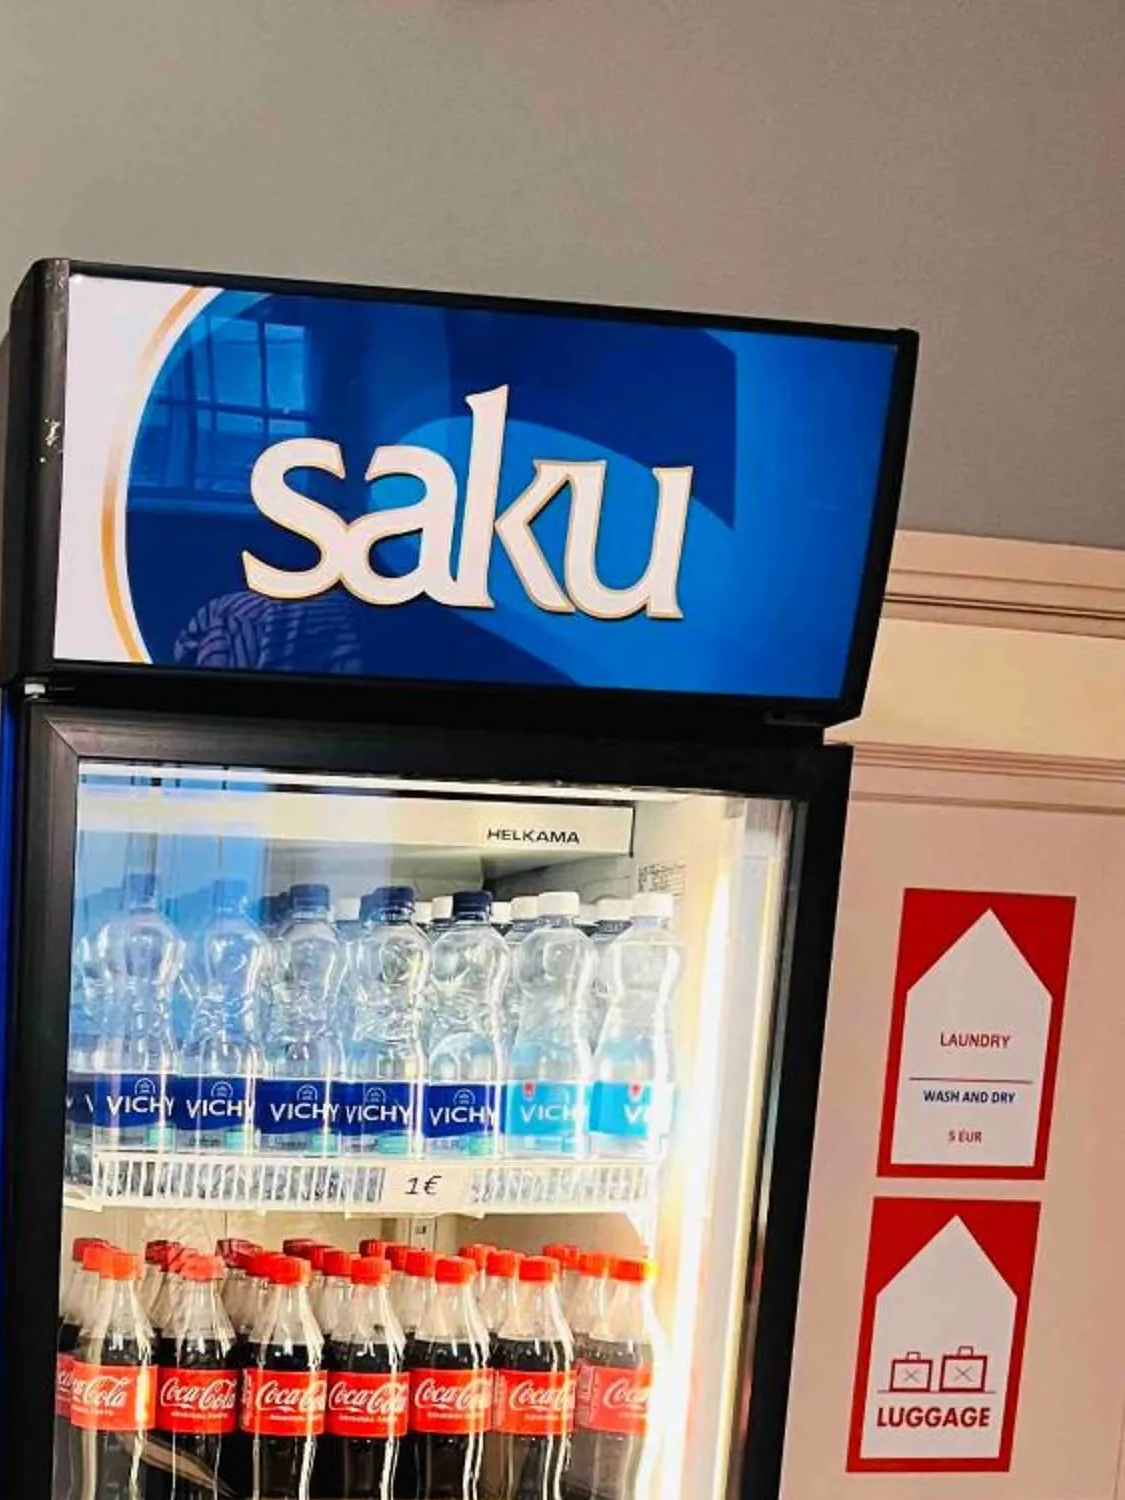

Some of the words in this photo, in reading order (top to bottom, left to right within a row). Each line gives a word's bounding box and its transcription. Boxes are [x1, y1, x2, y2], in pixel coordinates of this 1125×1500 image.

[242, 384, 693, 620] saku
[487, 828, 579, 844] HELKAMA
[940, 1032, 1011, 1048] LAUNDRY
[107, 1095, 174, 1116] VICHY
[923, 1090, 960, 1102] WASH
[962, 1091, 988, 1103] AND
[991, 1092, 1015, 1104] DRY
[270, 1102, 339, 1123] VICHY
[345, 1104, 412, 1125] VICHY
[958, 1130, 982, 1142] EUR
[404, 1175, 442, 1195] 1€
[875, 1406, 991, 1428] LUGGAGE
